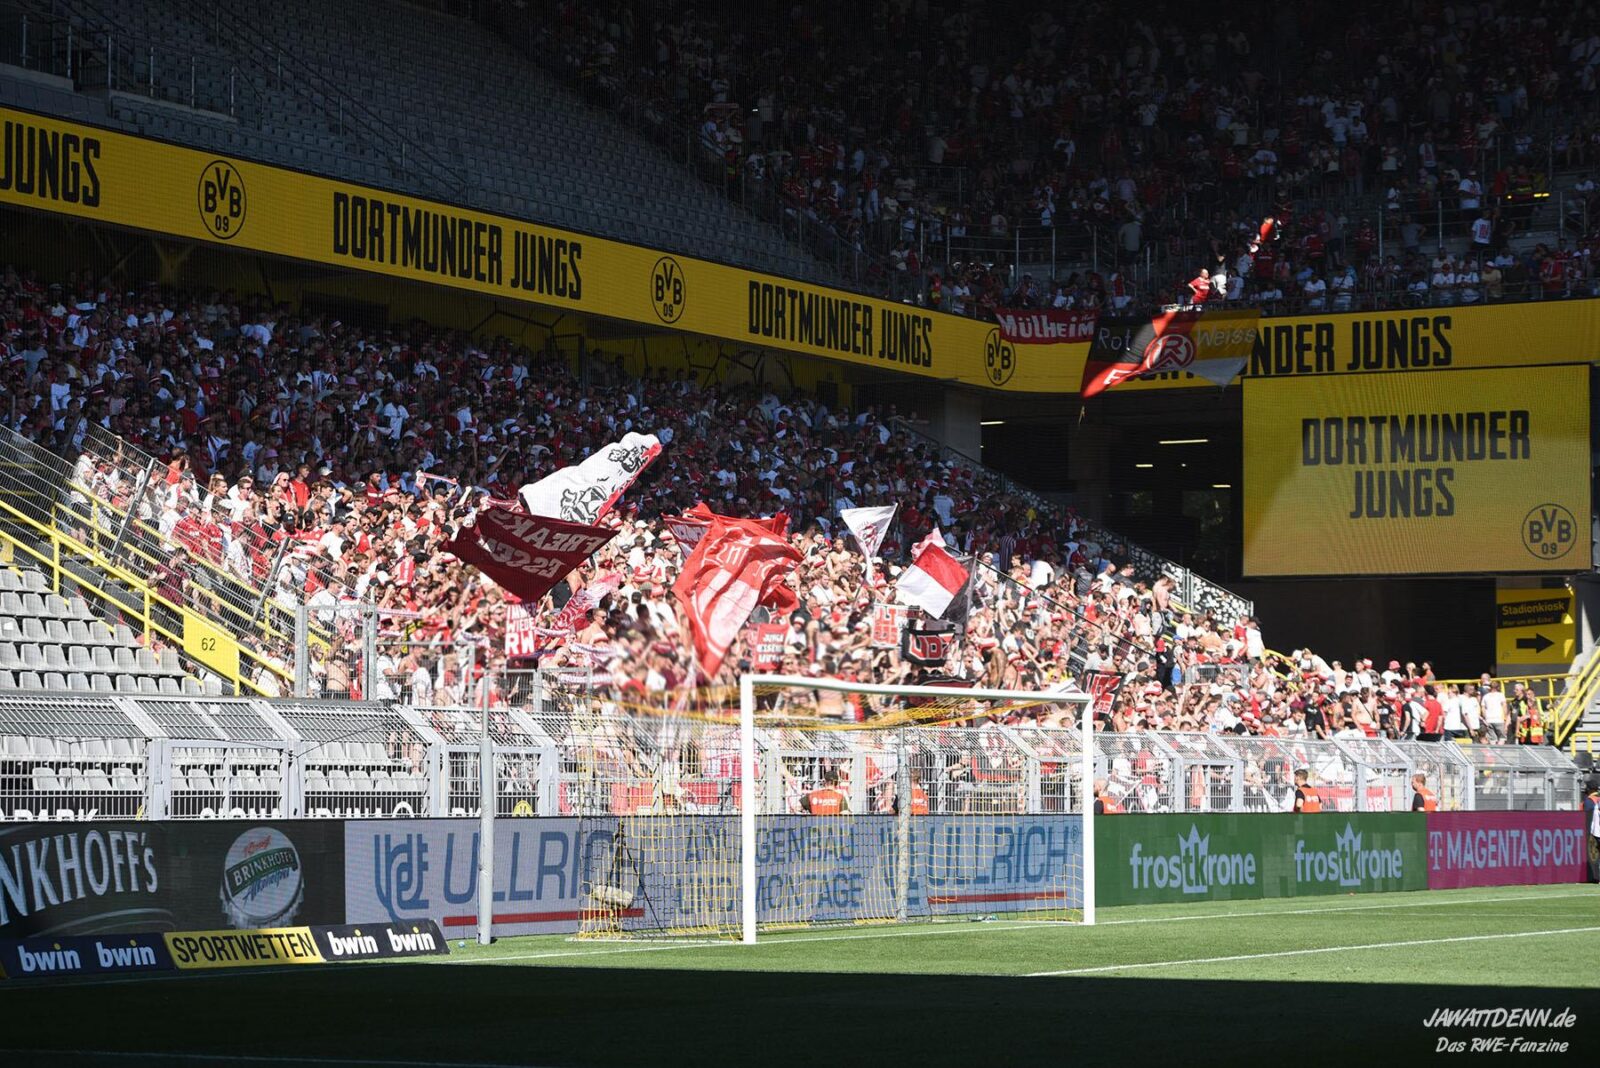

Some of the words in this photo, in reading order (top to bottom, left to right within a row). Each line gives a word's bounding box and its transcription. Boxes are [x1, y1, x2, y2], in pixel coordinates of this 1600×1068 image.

[0, 120, 101, 208] JUNGS
[203, 166, 243, 219] BVB
[214, 213, 230, 234] 09
[333, 191, 503, 287] DORTMUNDER
[510, 230, 583, 301] JUNGS
[655, 265, 684, 306] BVB
[662, 302, 675, 319] 09
[748, 279, 874, 357] DORTMUNDER
[878, 307, 933, 368] JUNGS
[1098, 326, 1133, 352] Rot
[1195, 324, 1258, 349] Weiss
[1346, 315, 1452, 371] JUNGS
[1301, 409, 1531, 467] DORTMUNDER
[1350, 468, 1455, 520] JUNGS
[1528, 508, 1573, 544] BVB
[1541, 542, 1558, 555] 09
[1501, 601, 1566, 616] Stadionkiosk
[201, 637, 216, 652] 62
[1130, 838, 1256, 891] frostkrone
[1295, 836, 1402, 885] frostkrone
[1446, 829, 1530, 869] MAGENTA
[1532, 828, 1584, 867] SPORT
[17, 943, 82, 973] bwin
[95, 939, 157, 968] bwin
[172, 932, 317, 963] SPORTWETTEN
[326, 929, 379, 956] bwin
[386, 926, 436, 952] bwin
